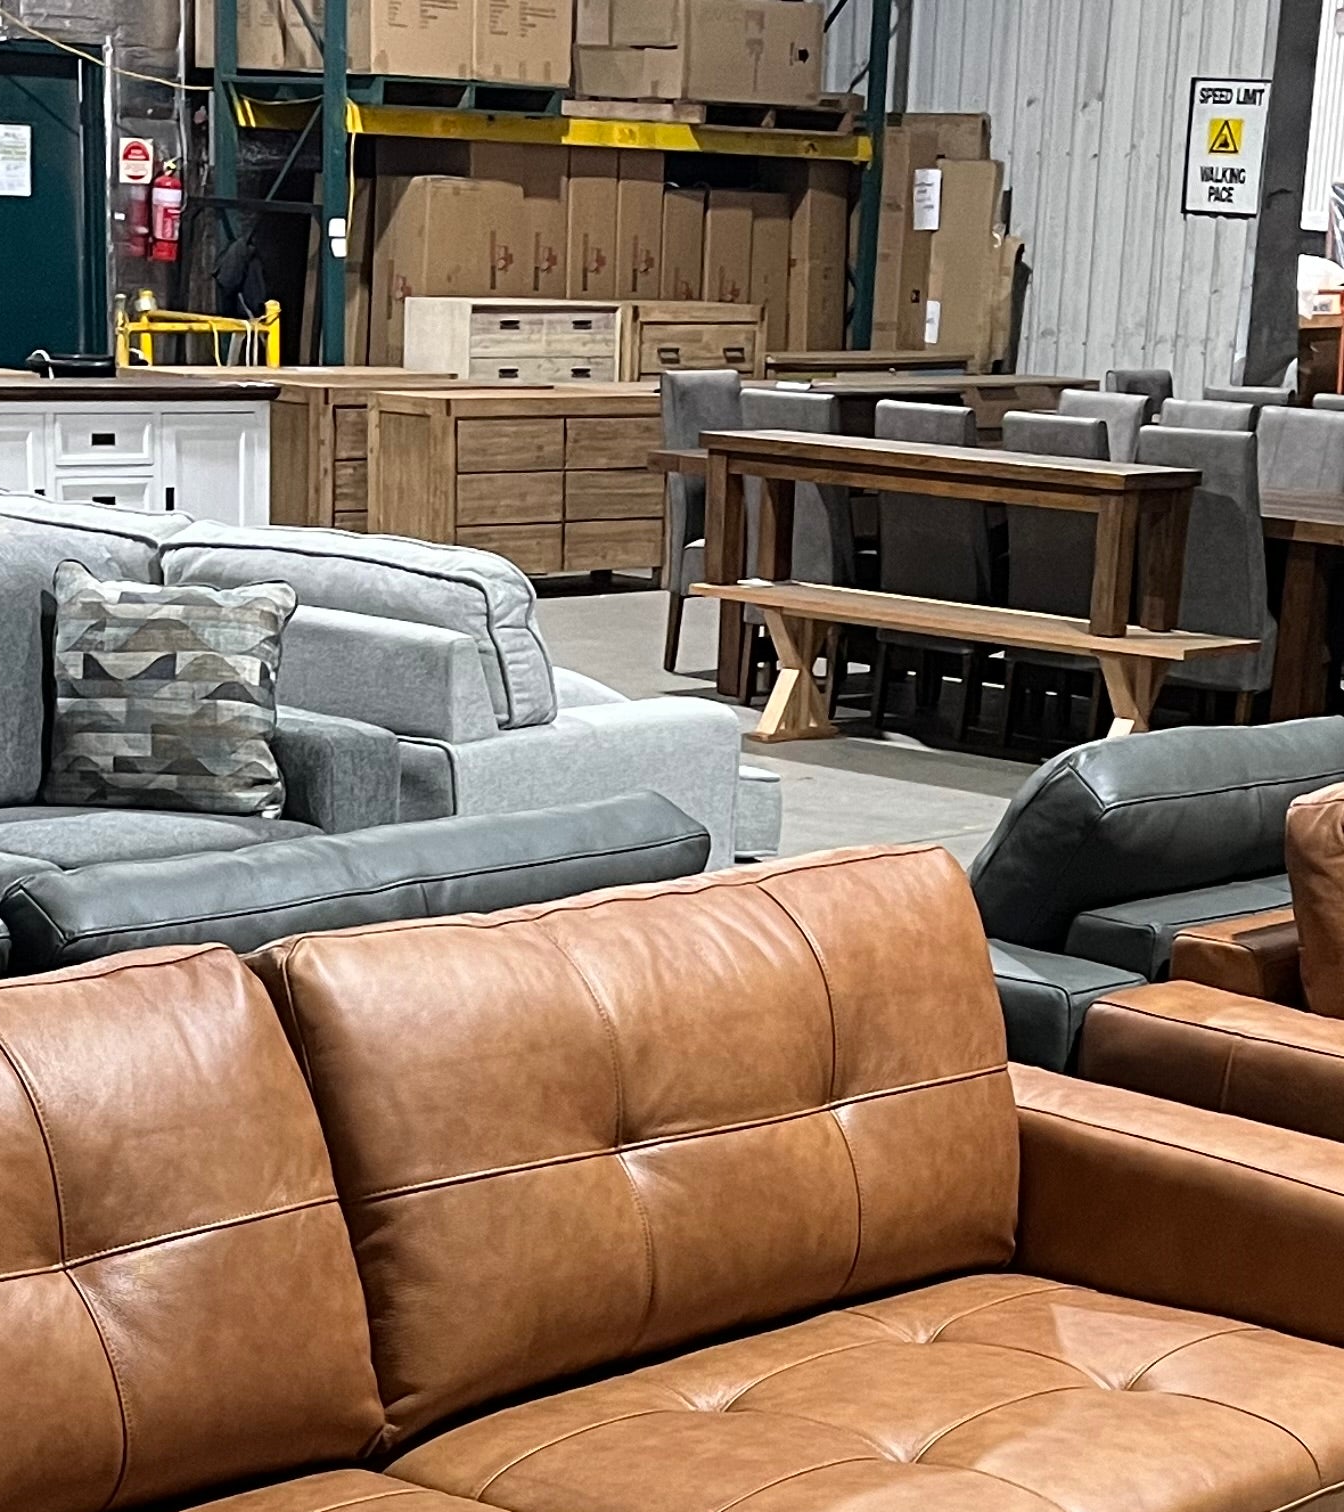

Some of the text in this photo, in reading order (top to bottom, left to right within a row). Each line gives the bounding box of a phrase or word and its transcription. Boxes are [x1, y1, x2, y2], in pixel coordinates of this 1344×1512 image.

[1199, 87, 1265, 106] SPEED LIMIT
[1200, 166, 1246, 184] WALKING
[1208, 186, 1235, 203] PACE
